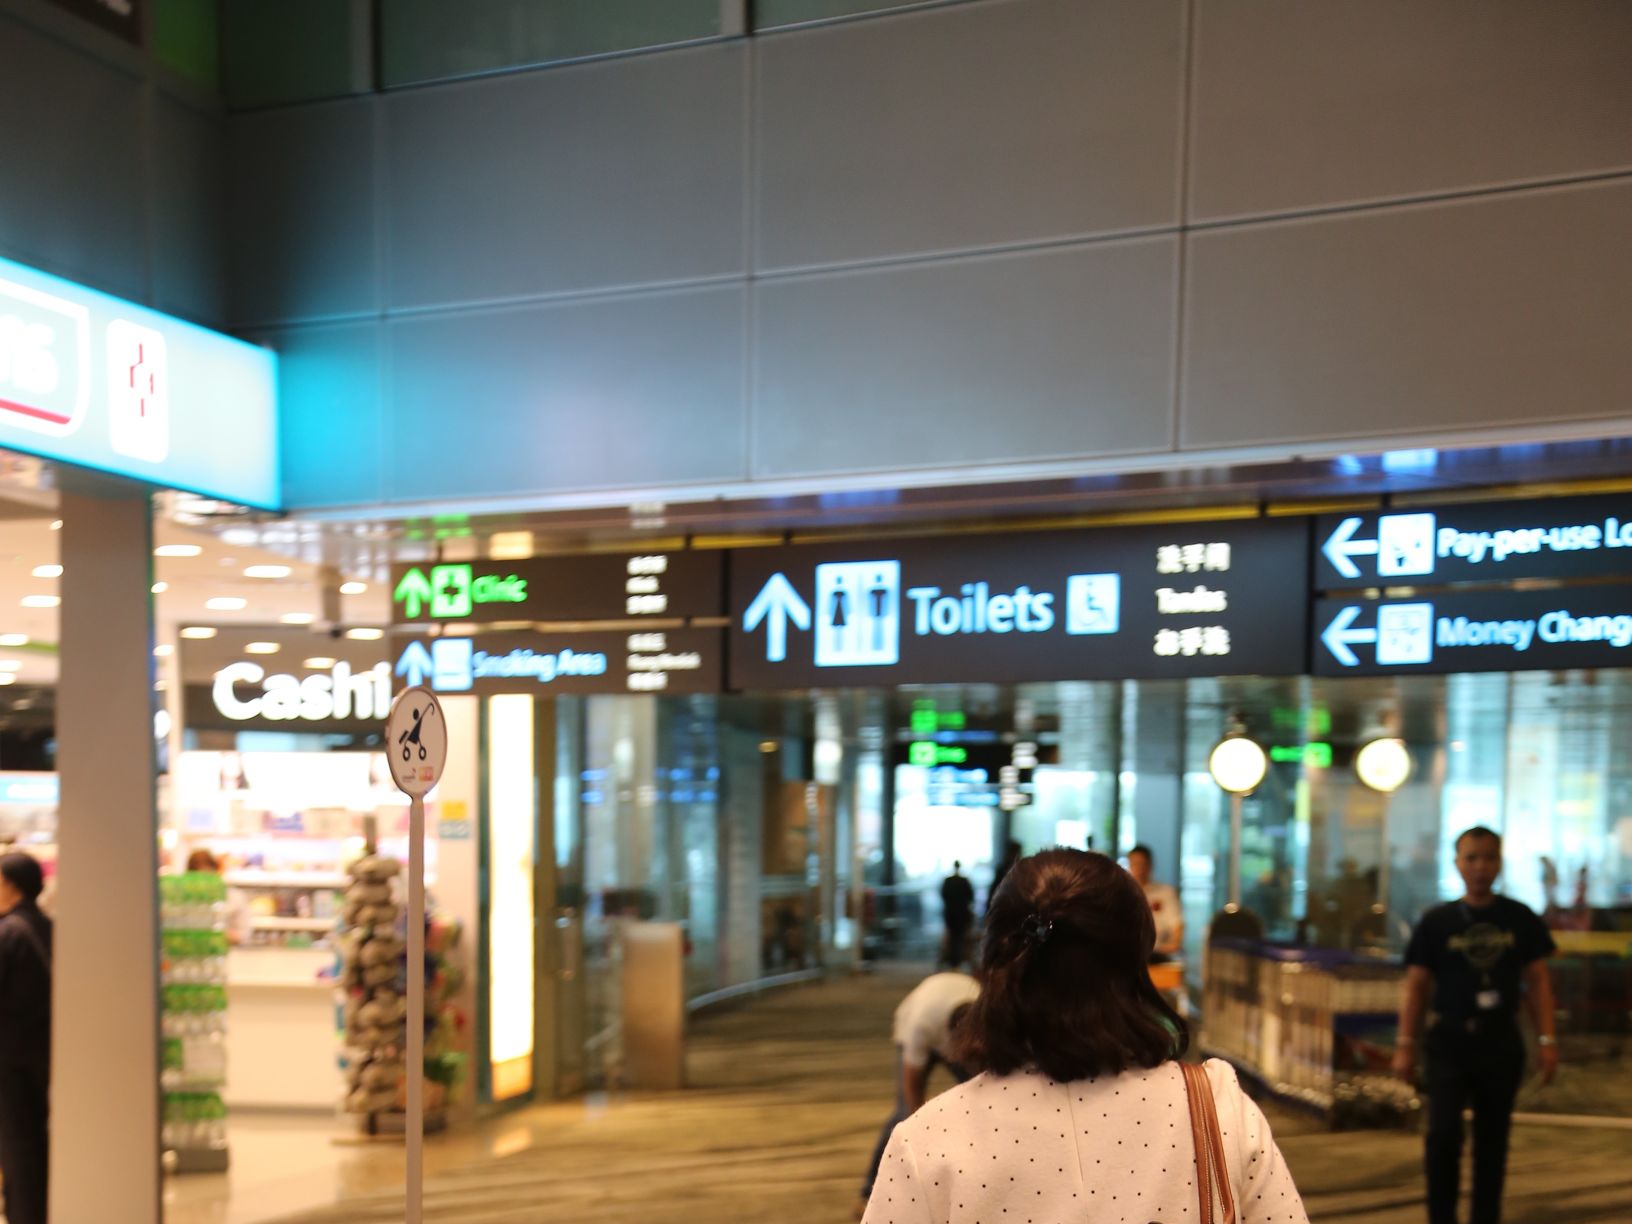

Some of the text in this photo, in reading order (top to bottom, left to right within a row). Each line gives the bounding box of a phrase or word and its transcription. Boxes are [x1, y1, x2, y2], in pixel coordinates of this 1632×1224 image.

[1437, 524, 1603, 563] Pay-per-use
[906, 582, 1056, 635] Toilets
[1436, 609, 1632, 652] Money Chang
[212, 661, 396, 720] Cashi
